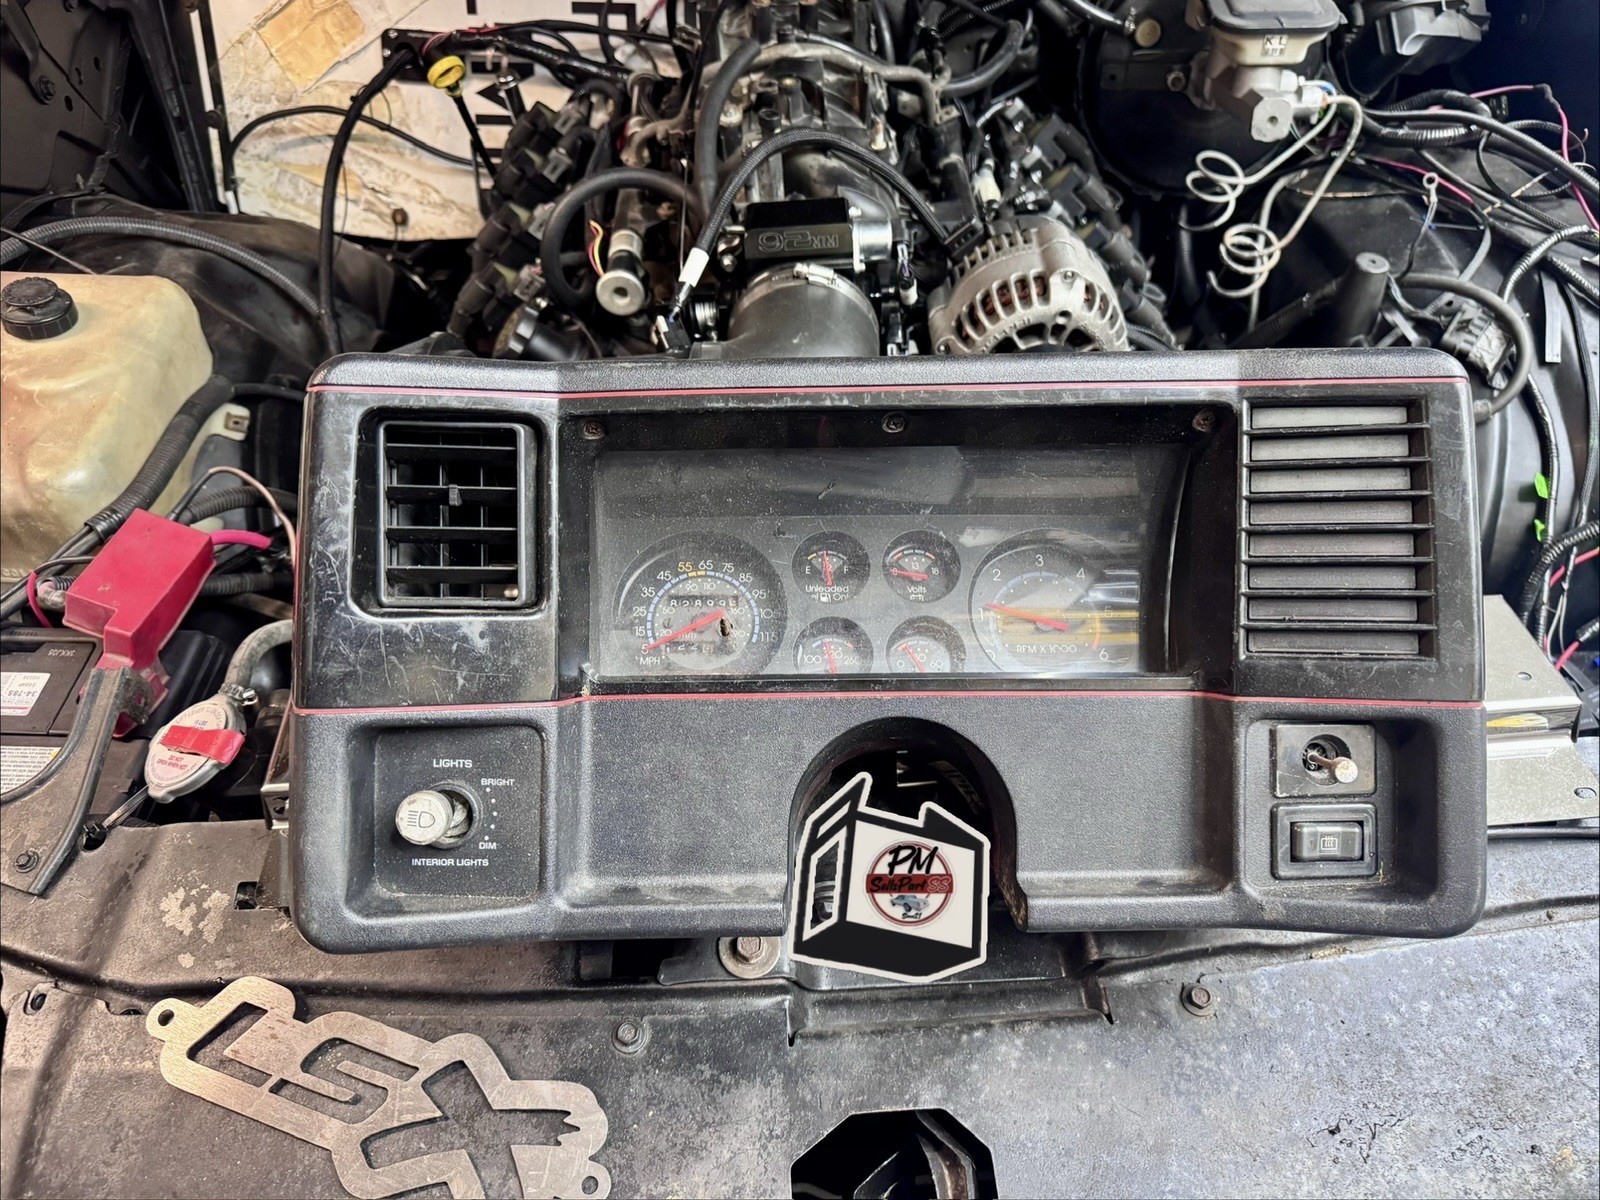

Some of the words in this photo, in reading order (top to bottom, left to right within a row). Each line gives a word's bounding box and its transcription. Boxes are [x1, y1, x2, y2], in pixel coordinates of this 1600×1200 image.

[698, 559, 714, 570] 65
[1035, 553, 1044, 567] 3
[677, 561, 693, 572] 55
[721, 562, 735, 573] 75
[805, 565, 811, 575] E
[843, 566, 850, 574] F
[911, 562, 920, 570] 13
[931, 567, 940, 576] 18
[656, 570, 672, 581] 45
[738, 572, 753, 583] 85
[992, 568, 1002, 581] 2
[1076, 567, 1085, 579] 4
[641, 586, 656, 597] 35
[751, 588, 767, 599] 95
[805, 584, 849, 593] Unleaded
[906, 585, 927, 594] Volts
[632, 605, 647, 617] 25
[661, 606, 675, 615] 50
[978, 607, 983, 621] 1
[1104, 605, 1113, 618] 5
[634, 626, 646, 637] 15
[759, 631, 779, 642] 115
[641, 643, 649, 655] 5
[1016, 644, 1037, 653] RPM
[1040, 645, 1047, 653] X
[1049, 644, 1078, 653] 1000
[1099, 647, 1109, 661] 6
[639, 656, 661, 666] MPH
[803, 654, 822, 665] 100
[896, 659, 905, 669] 0
[930, 659, 944, 669] 60
[433, 759, 473, 769] LIGHTS
[481, 778, 515, 787] BRIGHT
[478, 842, 497, 850] DIM
[411, 858, 455, 867] INTERIOR
[456, 858, 489, 867] LIGHTS
